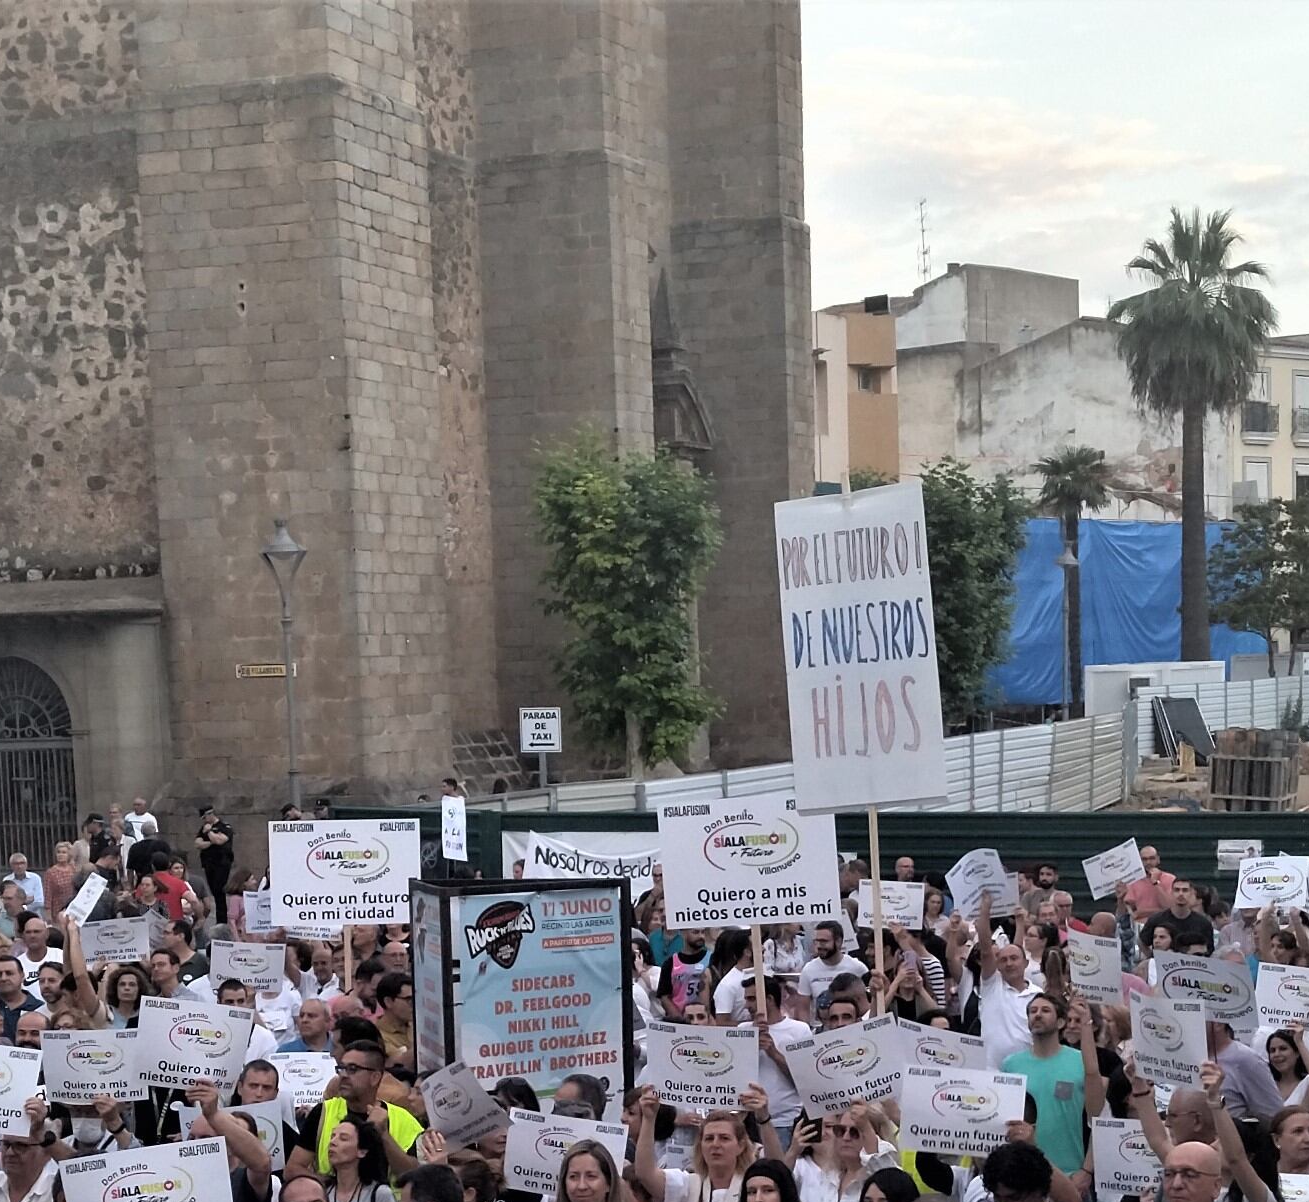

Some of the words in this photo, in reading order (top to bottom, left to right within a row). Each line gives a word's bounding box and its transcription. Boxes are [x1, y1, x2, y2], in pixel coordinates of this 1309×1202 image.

[781, 536, 811, 590] POR
[813, 533, 832, 585] EL
[792, 610, 817, 669] DE
[821, 597, 929, 667] NUESTROS
[523, 712, 557, 720] PARADA
[535, 722, 546, 730] DE
[530, 732, 552, 741] TAXI
[703, 819, 724, 834] Don
[726, 810, 754, 826] Benito
[308, 836, 323, 848] Don
[325, 830, 351, 841] Benito
[535, 843, 609, 876] Nosotros
[740, 847, 774, 859] Futuro
[282, 893, 332, 908] Quiero
[339, 894, 356, 904] un
[362, 892, 410, 904] futuro
[697, 888, 756, 905] Quiero
[761, 889, 770, 899] a
[776, 882, 807, 899] mis
[298, 911, 317, 920] en
[323, 908, 340, 920] mi
[345, 907, 394, 920] ciudad
[560, 898, 611, 916] JUNIO
[675, 905, 728, 921] nietos
[734, 904, 780, 918] cerca
[784, 902, 805, 916] de
[810, 899, 832, 914] mí
[512, 974, 575, 992] SIDECARS
[495, 1001, 517, 1015] DR.
[523, 993, 591, 1012] FEELGOOD
[508, 1018, 545, 1034] NIKKI
[552, 1015, 578, 1030] HILL
[479, 1040, 534, 1058] QUIQUE
[539, 1030, 607, 1051] GONZÁLEZ
[550, 1050, 617, 1071] BROTHERS
